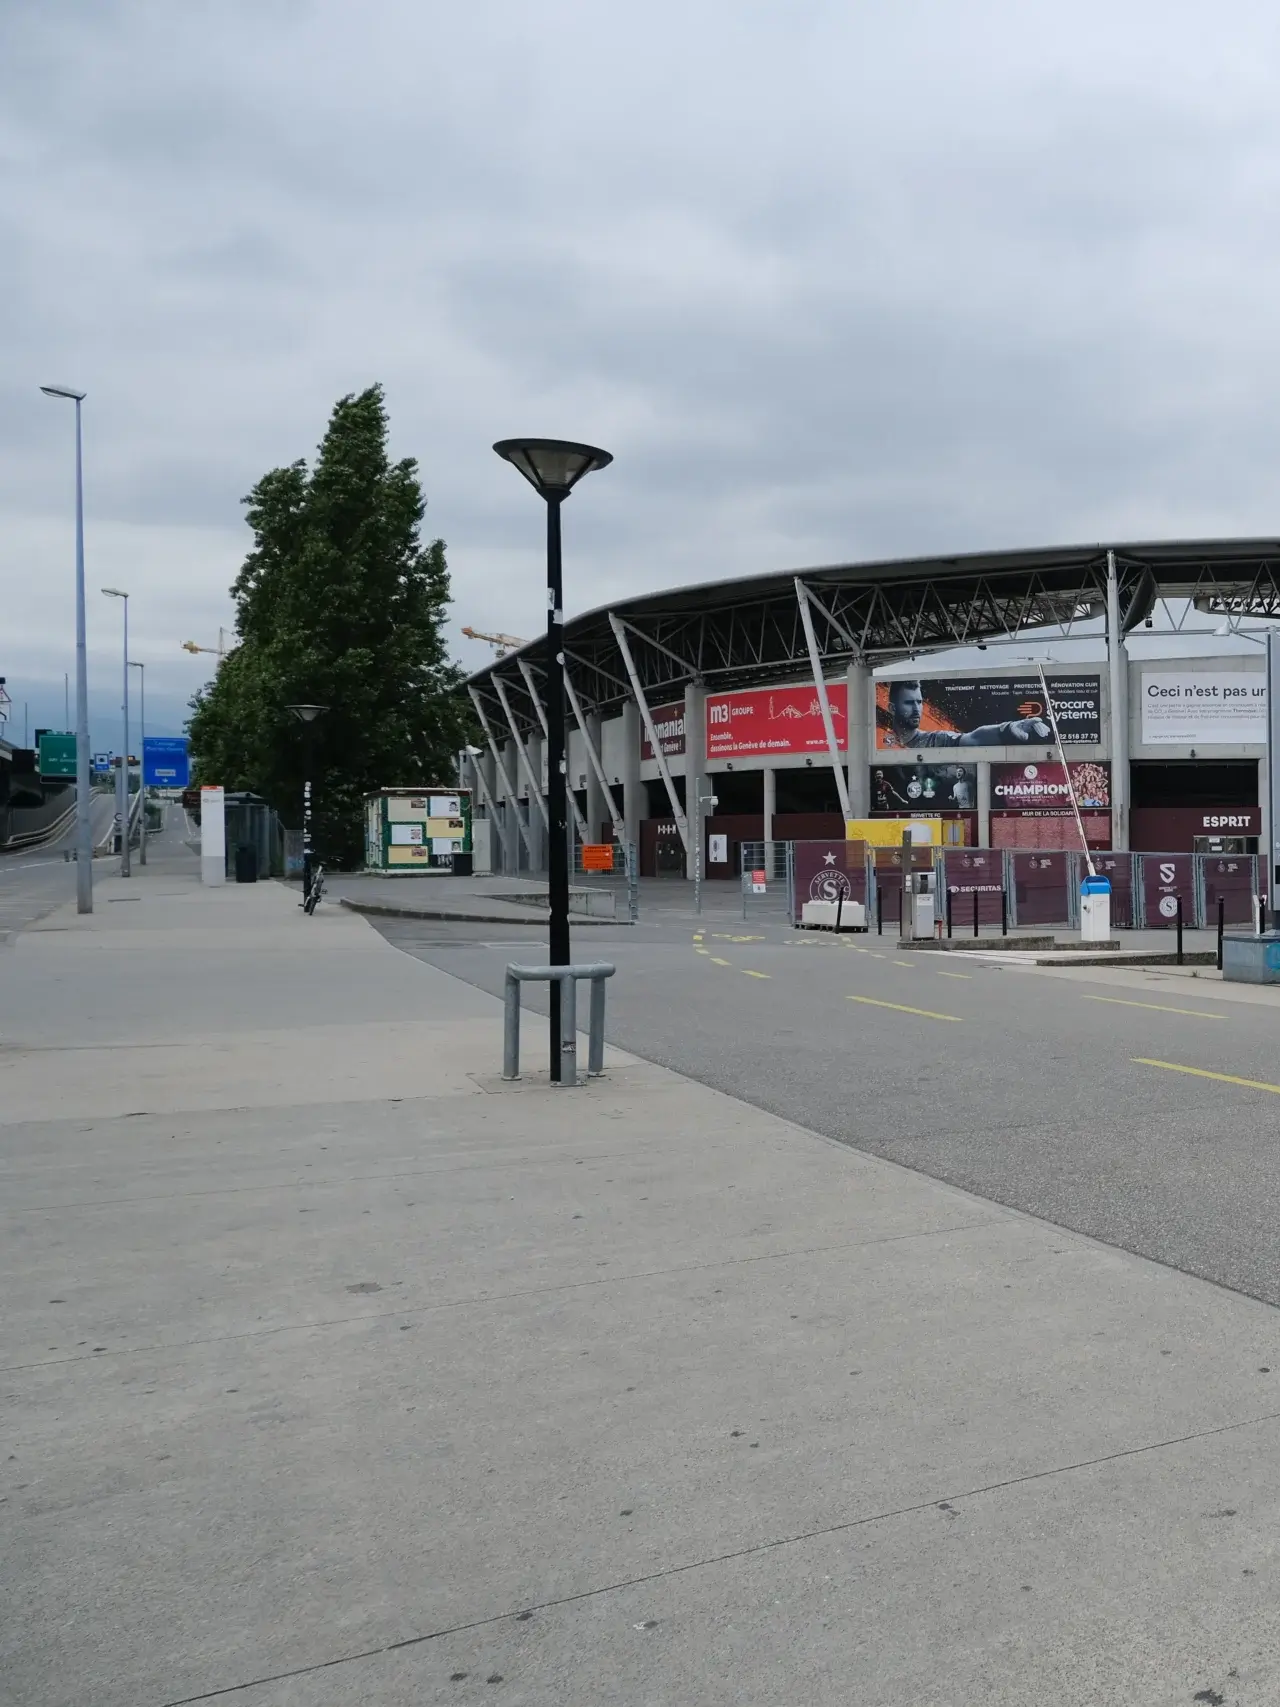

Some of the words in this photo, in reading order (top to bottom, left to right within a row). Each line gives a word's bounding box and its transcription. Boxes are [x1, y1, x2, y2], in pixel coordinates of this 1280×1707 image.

[1147, 684, 1180, 698] Ceci
[1184, 683, 1219, 697] n'est
[1223, 686, 1248, 700] pas
[732, 706, 754, 715] GROUPE
[1202, 815, 1252, 828] ESPRIT
[960, 885, 1001, 893] SECURITAS
